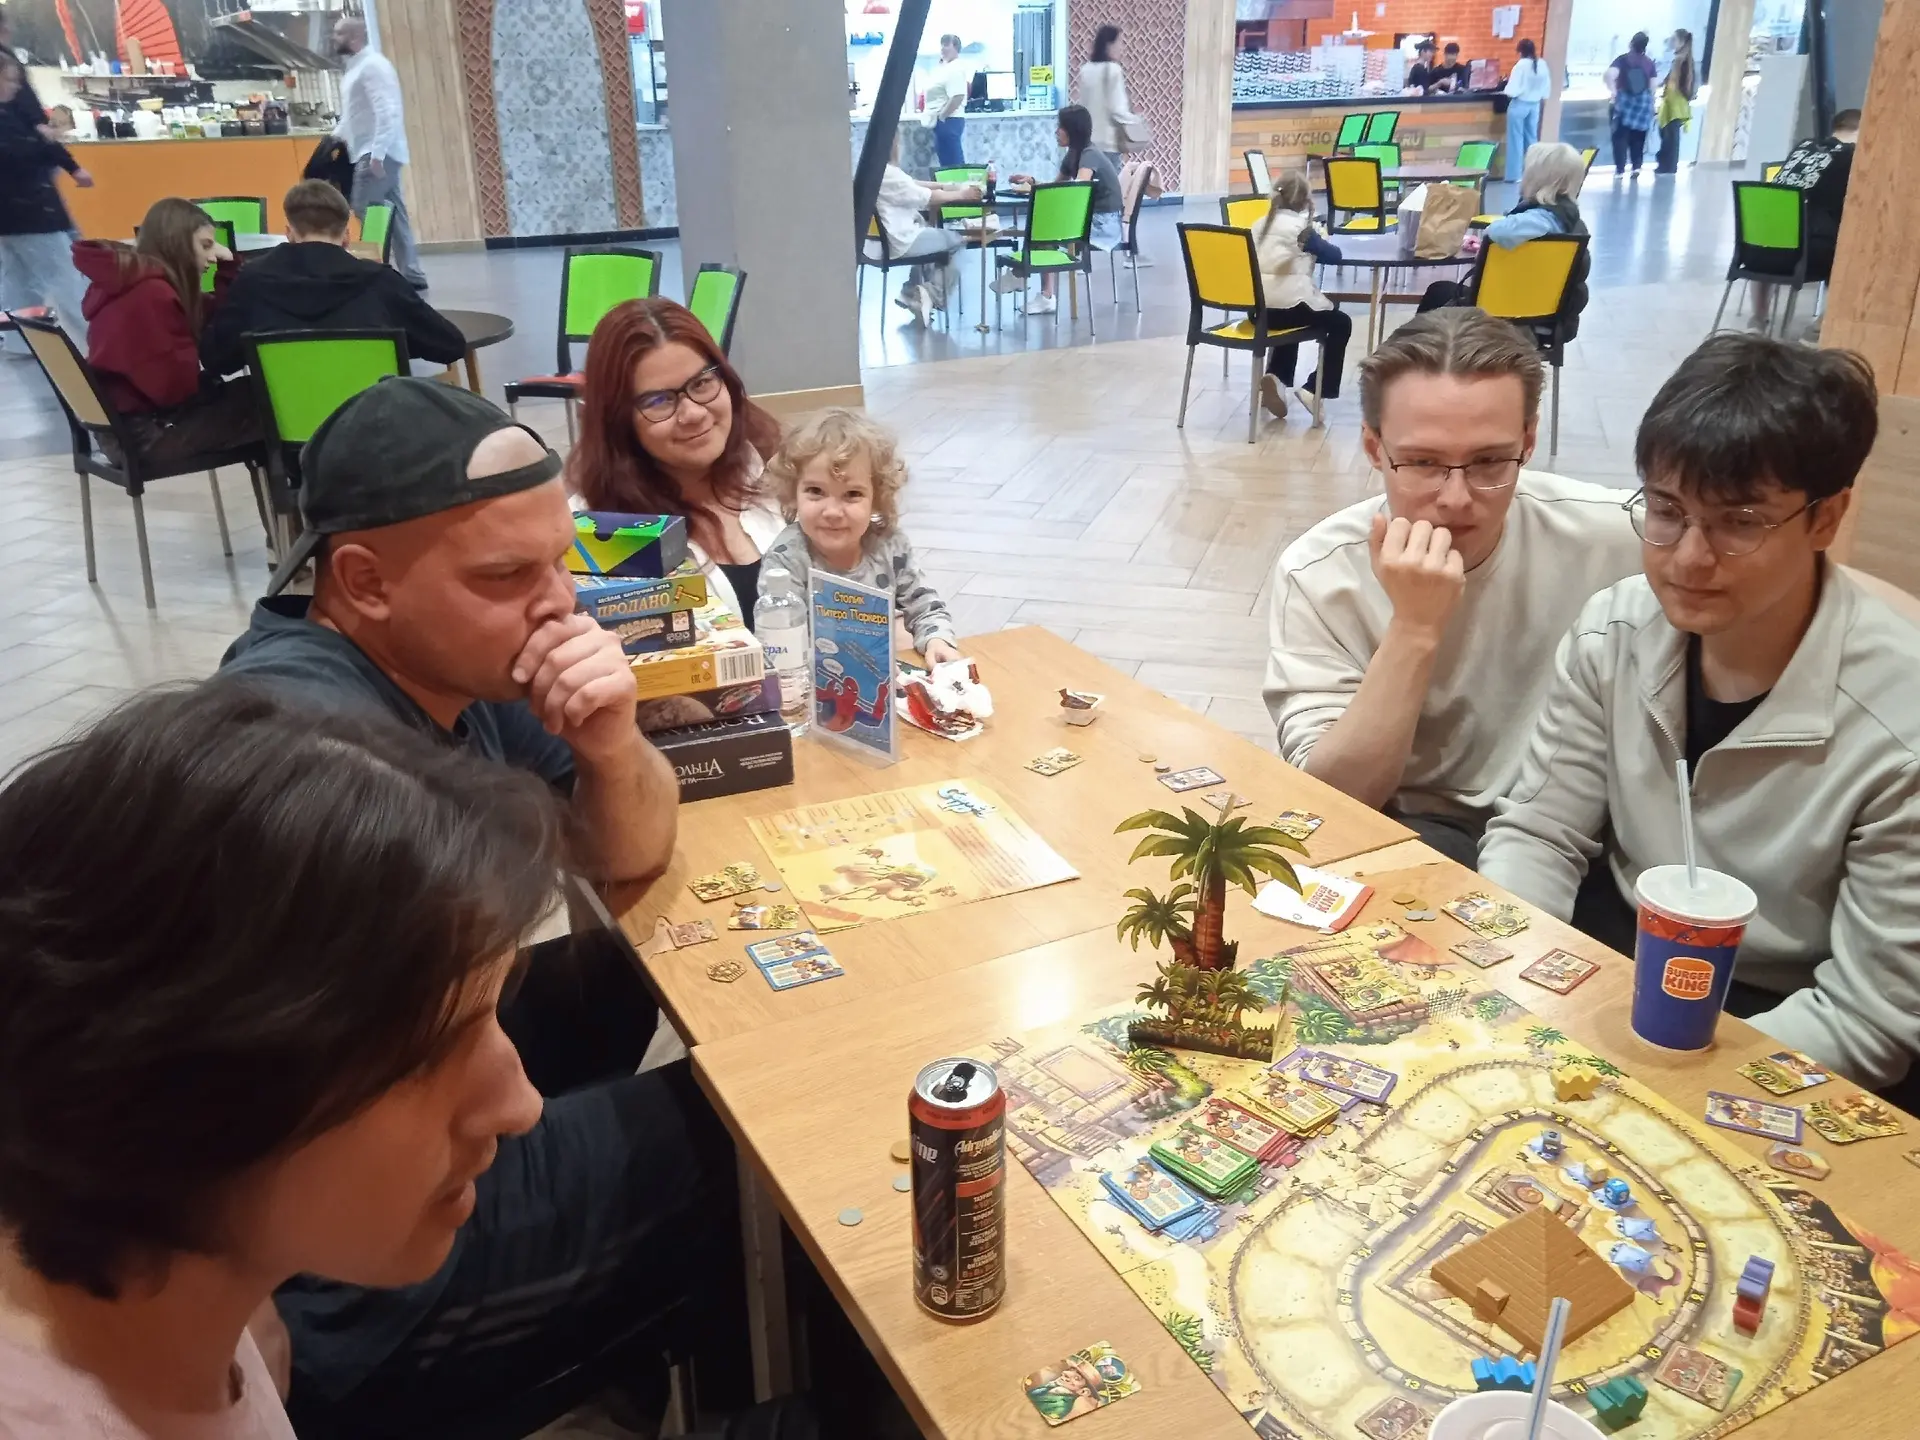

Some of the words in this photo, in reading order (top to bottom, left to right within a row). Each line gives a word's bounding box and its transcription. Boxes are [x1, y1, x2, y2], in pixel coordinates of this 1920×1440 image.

[1271, 131, 1333, 148] ВКУСНО
[596, 592, 671, 618] ПРОДАНО
[833, 591, 865, 605] Столик
[815, 604, 848, 620] Питера
[850, 608, 888, 626] Паркера
[674, 757, 724, 777] ОЛЬЦА
[1306, 884, 1329, 908] BURGER
[1315, 889, 1340, 914] KING
[1666, 966, 1711, 980] BURGER
[1664, 977, 1710, 992] KING
[1360, 1339, 1376, 1352] 14
[1645, 1347, 1662, 1359] 10
[1405, 1377, 1421, 1390] 13
[1570, 1382, 1586, 1394] 11
